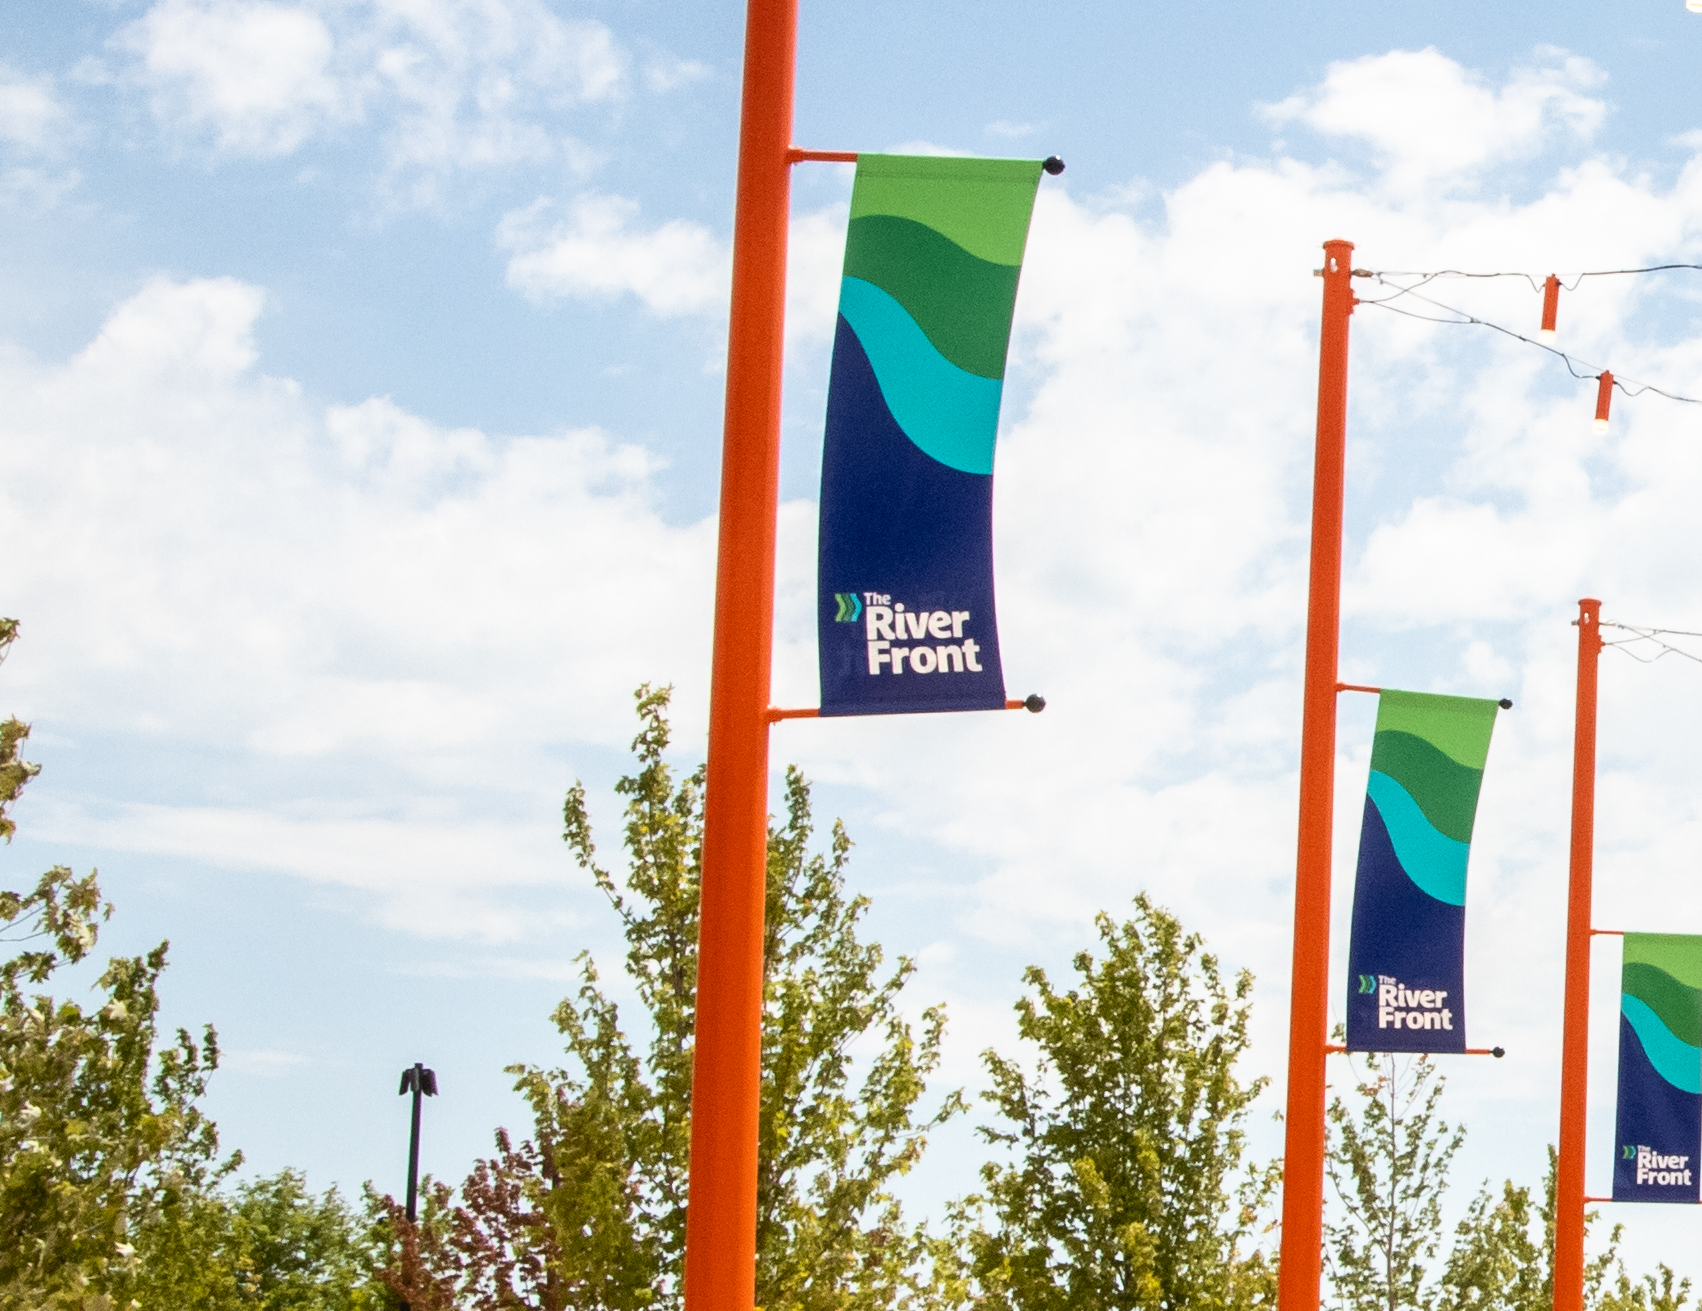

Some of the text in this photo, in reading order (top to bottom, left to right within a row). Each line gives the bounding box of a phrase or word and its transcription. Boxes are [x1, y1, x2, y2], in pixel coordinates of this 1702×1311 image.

[864, 592, 891, 606] The
[866, 602, 970, 640] River
[868, 638, 983, 675] Front
[1378, 975, 1396, 985] The
[1379, 983, 1448, 1008] River
[1379, 1006, 1453, 1030] Front
[1638, 1151, 1689, 1169] River
[1636, 1168, 1692, 1185] Front
